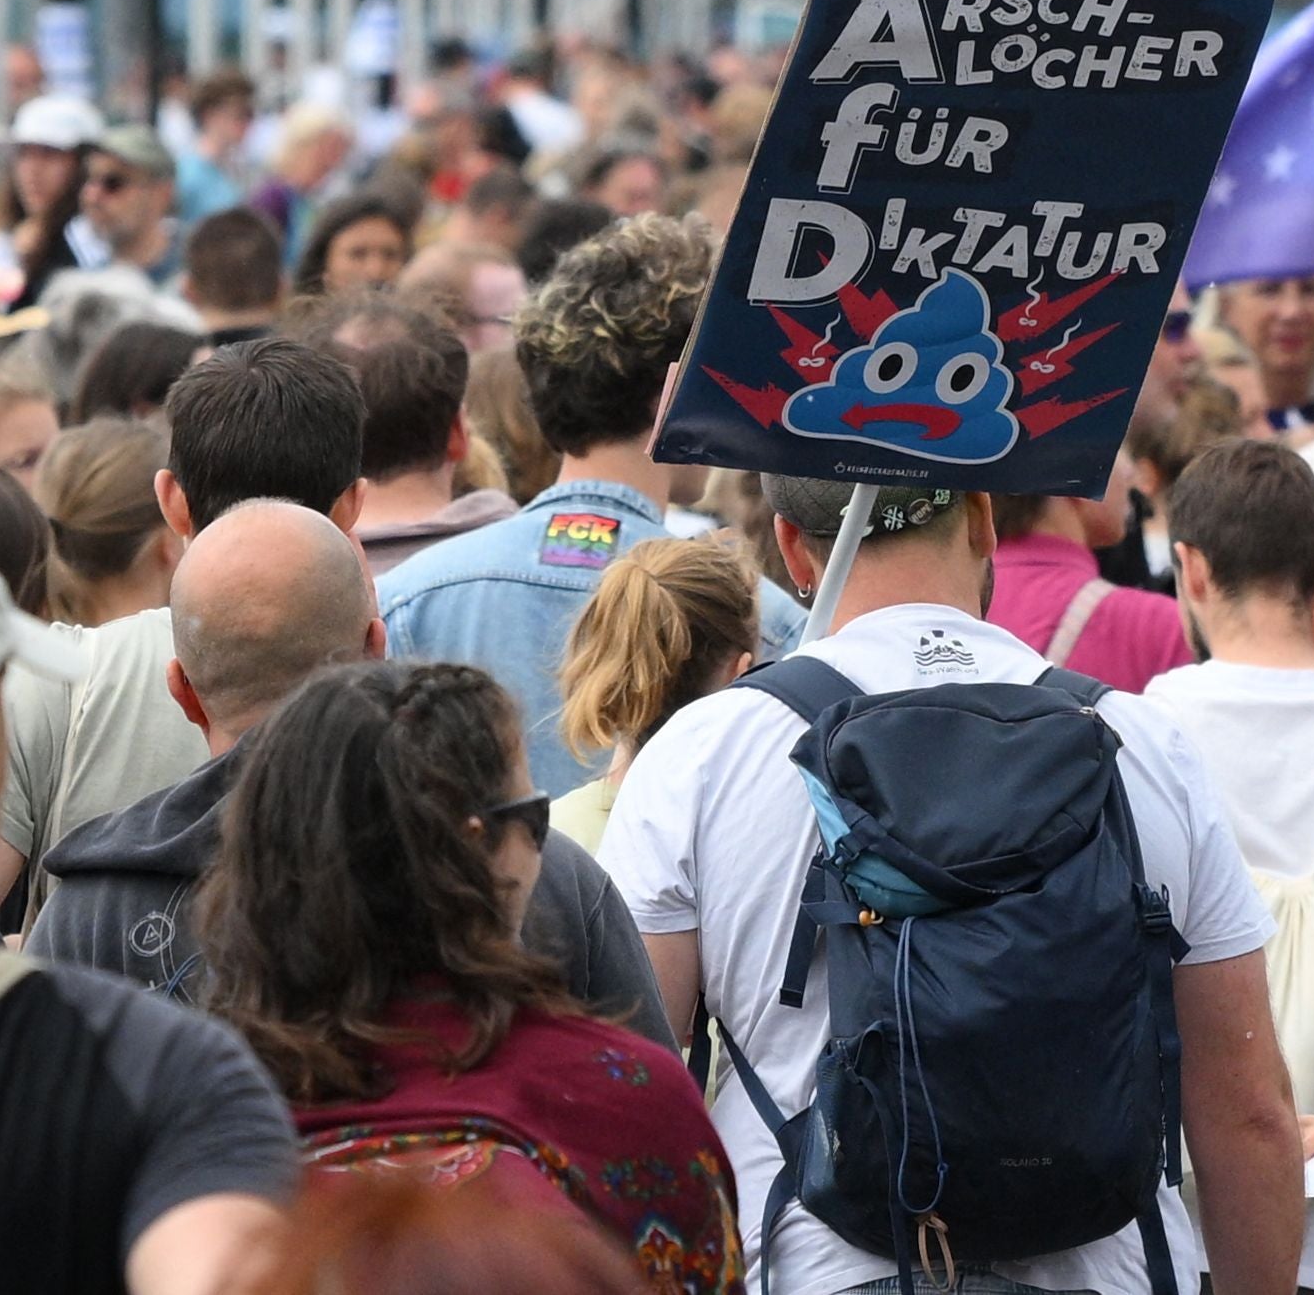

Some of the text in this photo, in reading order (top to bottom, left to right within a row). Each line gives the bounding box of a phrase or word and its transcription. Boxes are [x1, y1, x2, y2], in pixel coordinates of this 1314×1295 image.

[955, 23, 1224, 90] LÖCHER
[747, 197, 1167, 307] DIKTATUR
[547, 516, 616, 544] FCK
